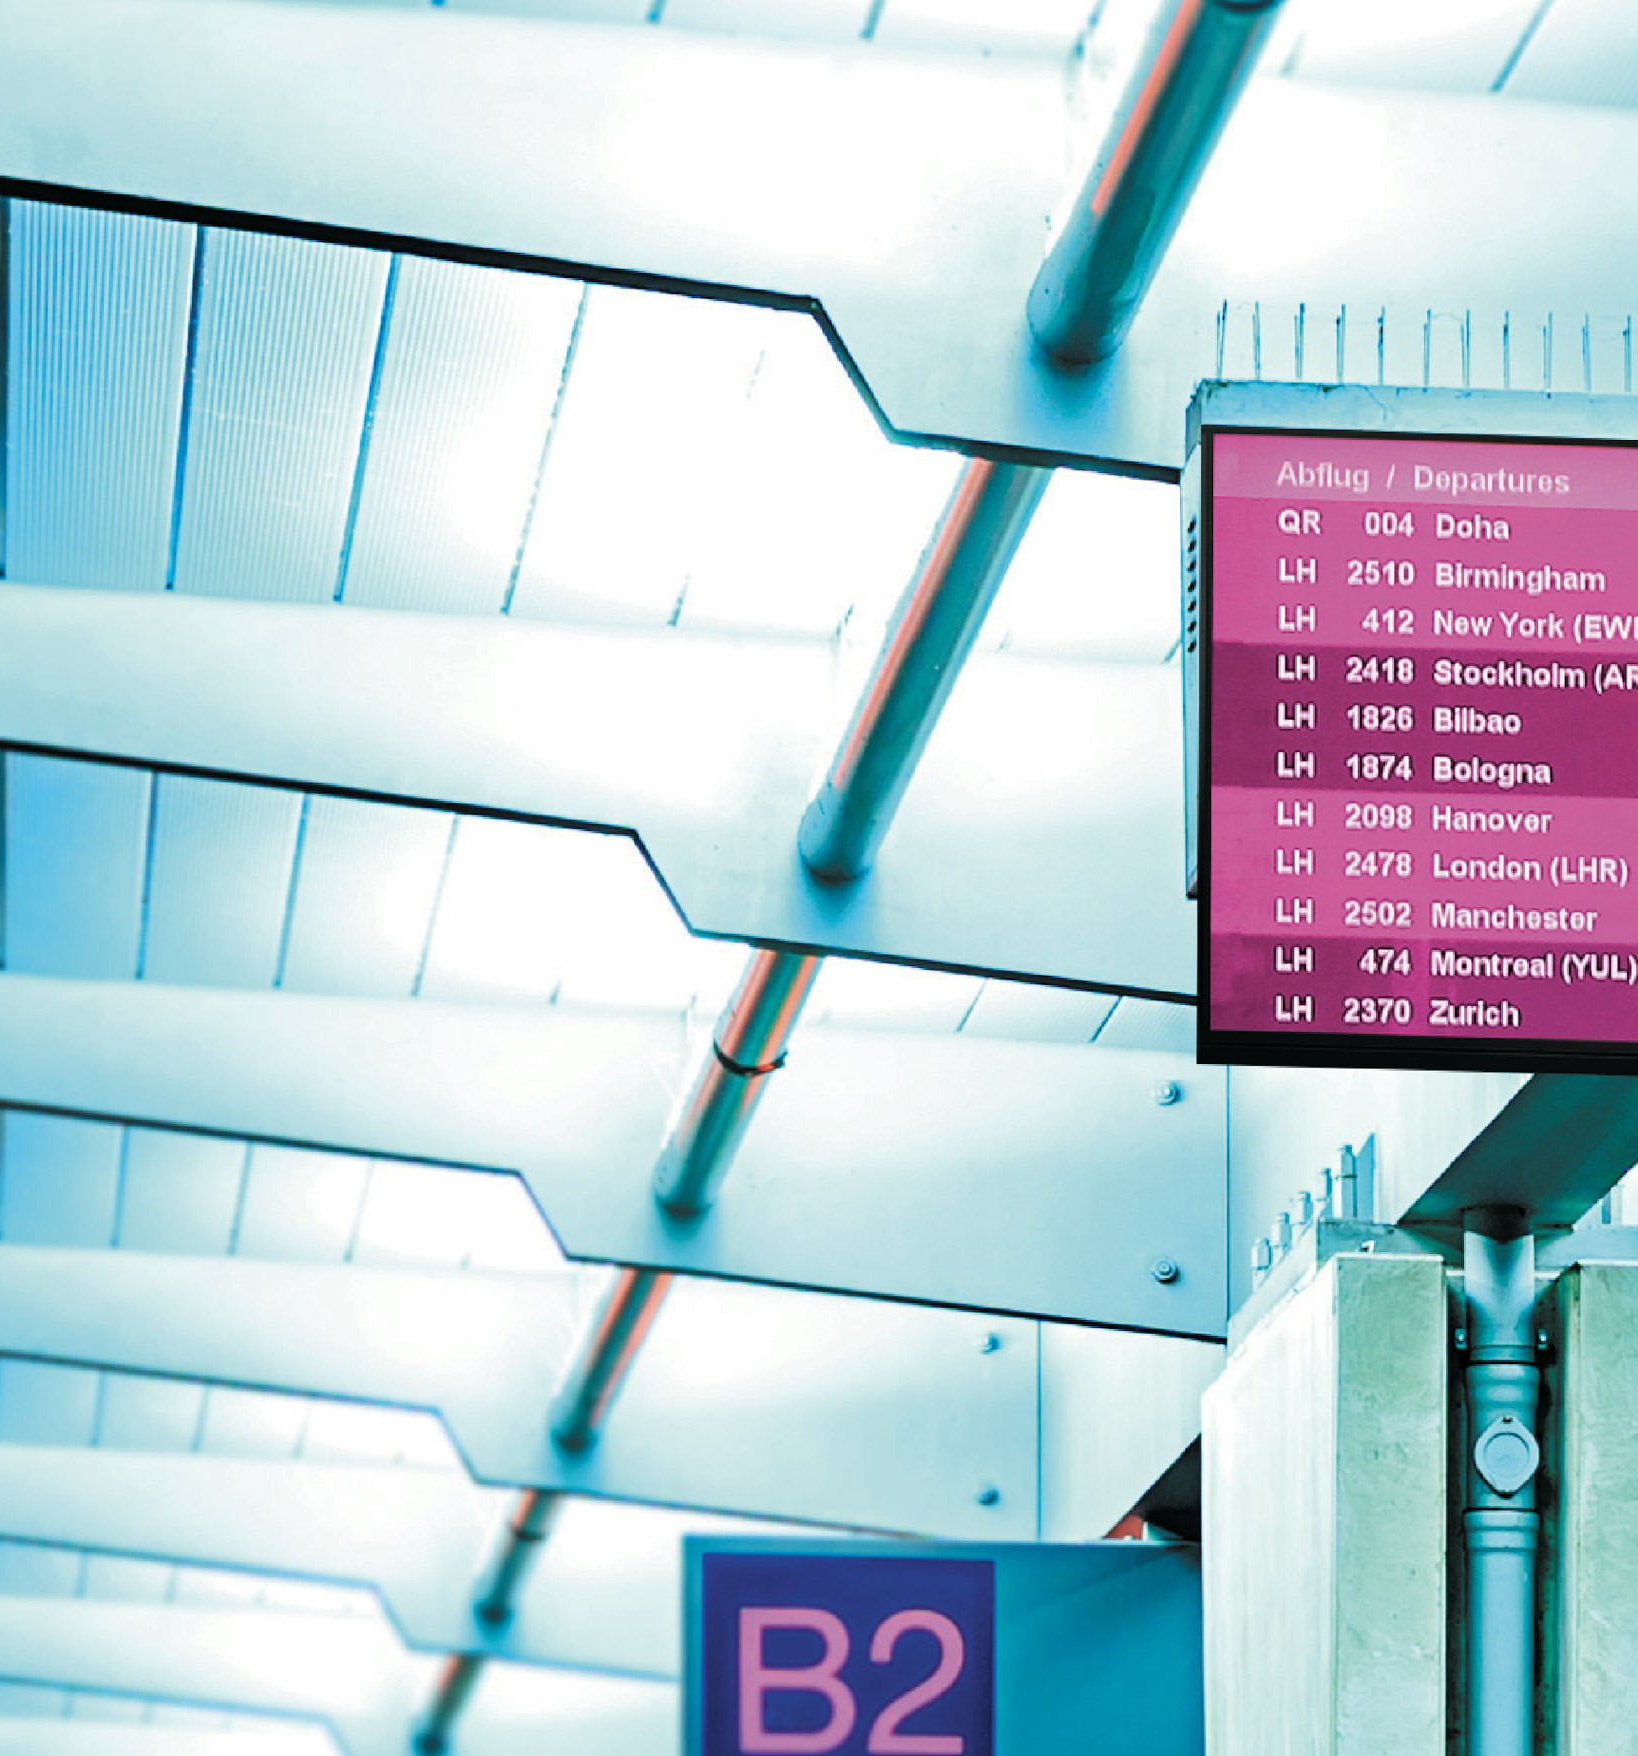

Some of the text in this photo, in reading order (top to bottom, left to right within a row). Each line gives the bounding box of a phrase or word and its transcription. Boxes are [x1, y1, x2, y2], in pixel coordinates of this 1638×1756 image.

[1277, 461, 1370, 493] Abflug
[1414, 465, 1570, 497] Departures
[1278, 509, 1321, 535] QR
[1365, 511, 1414, 537] 004
[1436, 512, 1509, 540] Doha
[1278, 557, 1316, 584] LH
[1347, 559, 1415, 586] 2510
[1435, 562, 1605, 595] Birmingham
[1278, 605, 1316, 632] LH
[1361, 607, 1414, 635] 412
[1433, 609, 1493, 637] New
[1498, 610, 1564, 639] York
[1277, 654, 1316, 682] LH
[1345, 656, 1414, 685] 2418
[1433, 659, 1586, 690] Stockholm
[1277, 702, 1316, 730] LH
[1347, 704, 1414, 732] 1826
[1433, 706, 1522, 735] Bilbao
[1277, 751, 1315, 779] LH
[1345, 753, 1412, 781] 1874
[1433, 756, 1551, 788] Bologna
[1277, 800, 1314, 828] LH
[1345, 802, 1412, 830] 2098
[1432, 804, 1553, 834] Hanover
[1277, 849, 1314, 876] LH
[1345, 850, 1412, 877] 2478
[1433, 853, 1542, 881] London
[1550, 856, 1628, 888] (LHR)
[1276, 898, 1313, 924] LH
[1344, 900, 1412, 927] 2502
[1431, 902, 1598, 932] Manchester
[1275, 946, 1313, 974] LH
[1359, 948, 1411, 976] 474
[1431, 949, 1554, 979] Montreal
[1561, 953, 1638, 986] (YUL)
[1275, 995, 1312, 1023] LH
[1344, 997, 1411, 1025] 2370
[1428, 999, 1519, 1028] Zurich
[738, 1606, 965, 1756] B2
